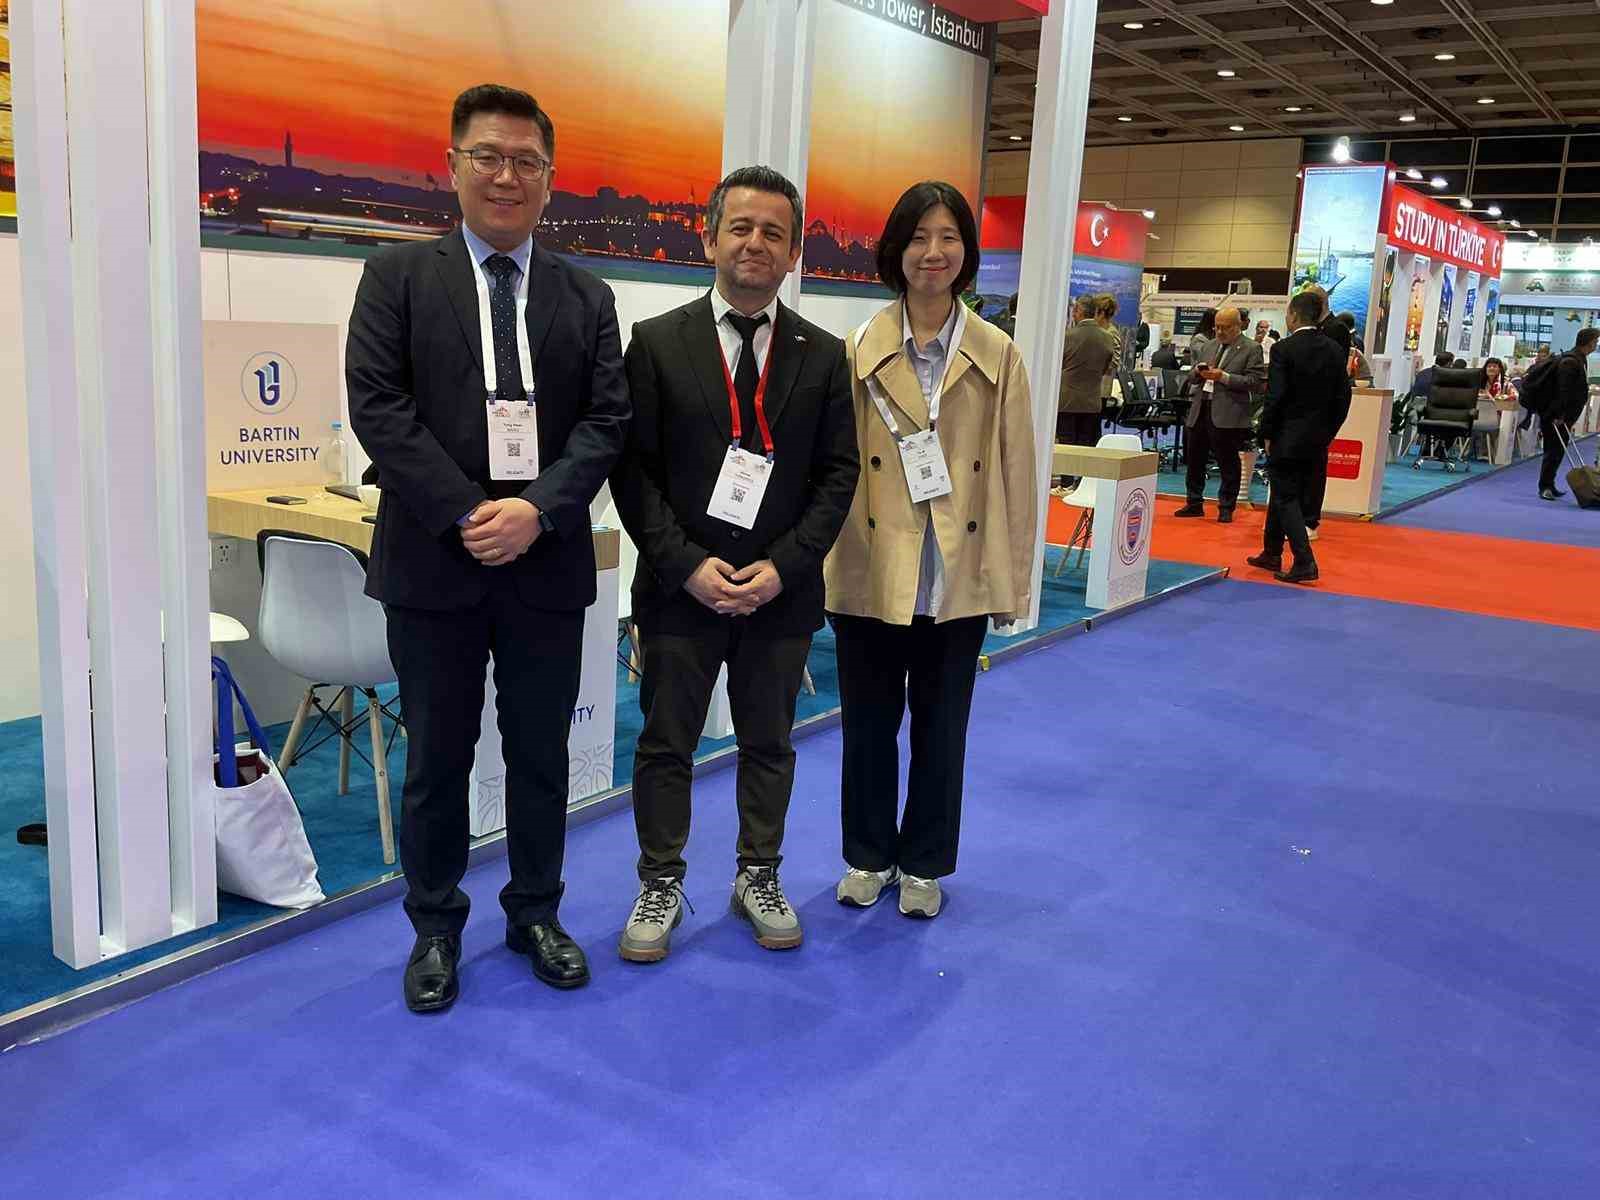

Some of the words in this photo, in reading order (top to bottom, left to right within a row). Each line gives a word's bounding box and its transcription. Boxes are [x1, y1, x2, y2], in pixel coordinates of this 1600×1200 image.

[1394, 201, 1435, 248] STUDY
[1434, 219, 1448, 254] IN
[1448, 219, 1487, 267] TÜRKİYE
[239, 426, 300, 442] BARTIN
[220, 447, 320, 465] UNIVERSITY
[572, 704, 595, 725] ITY
